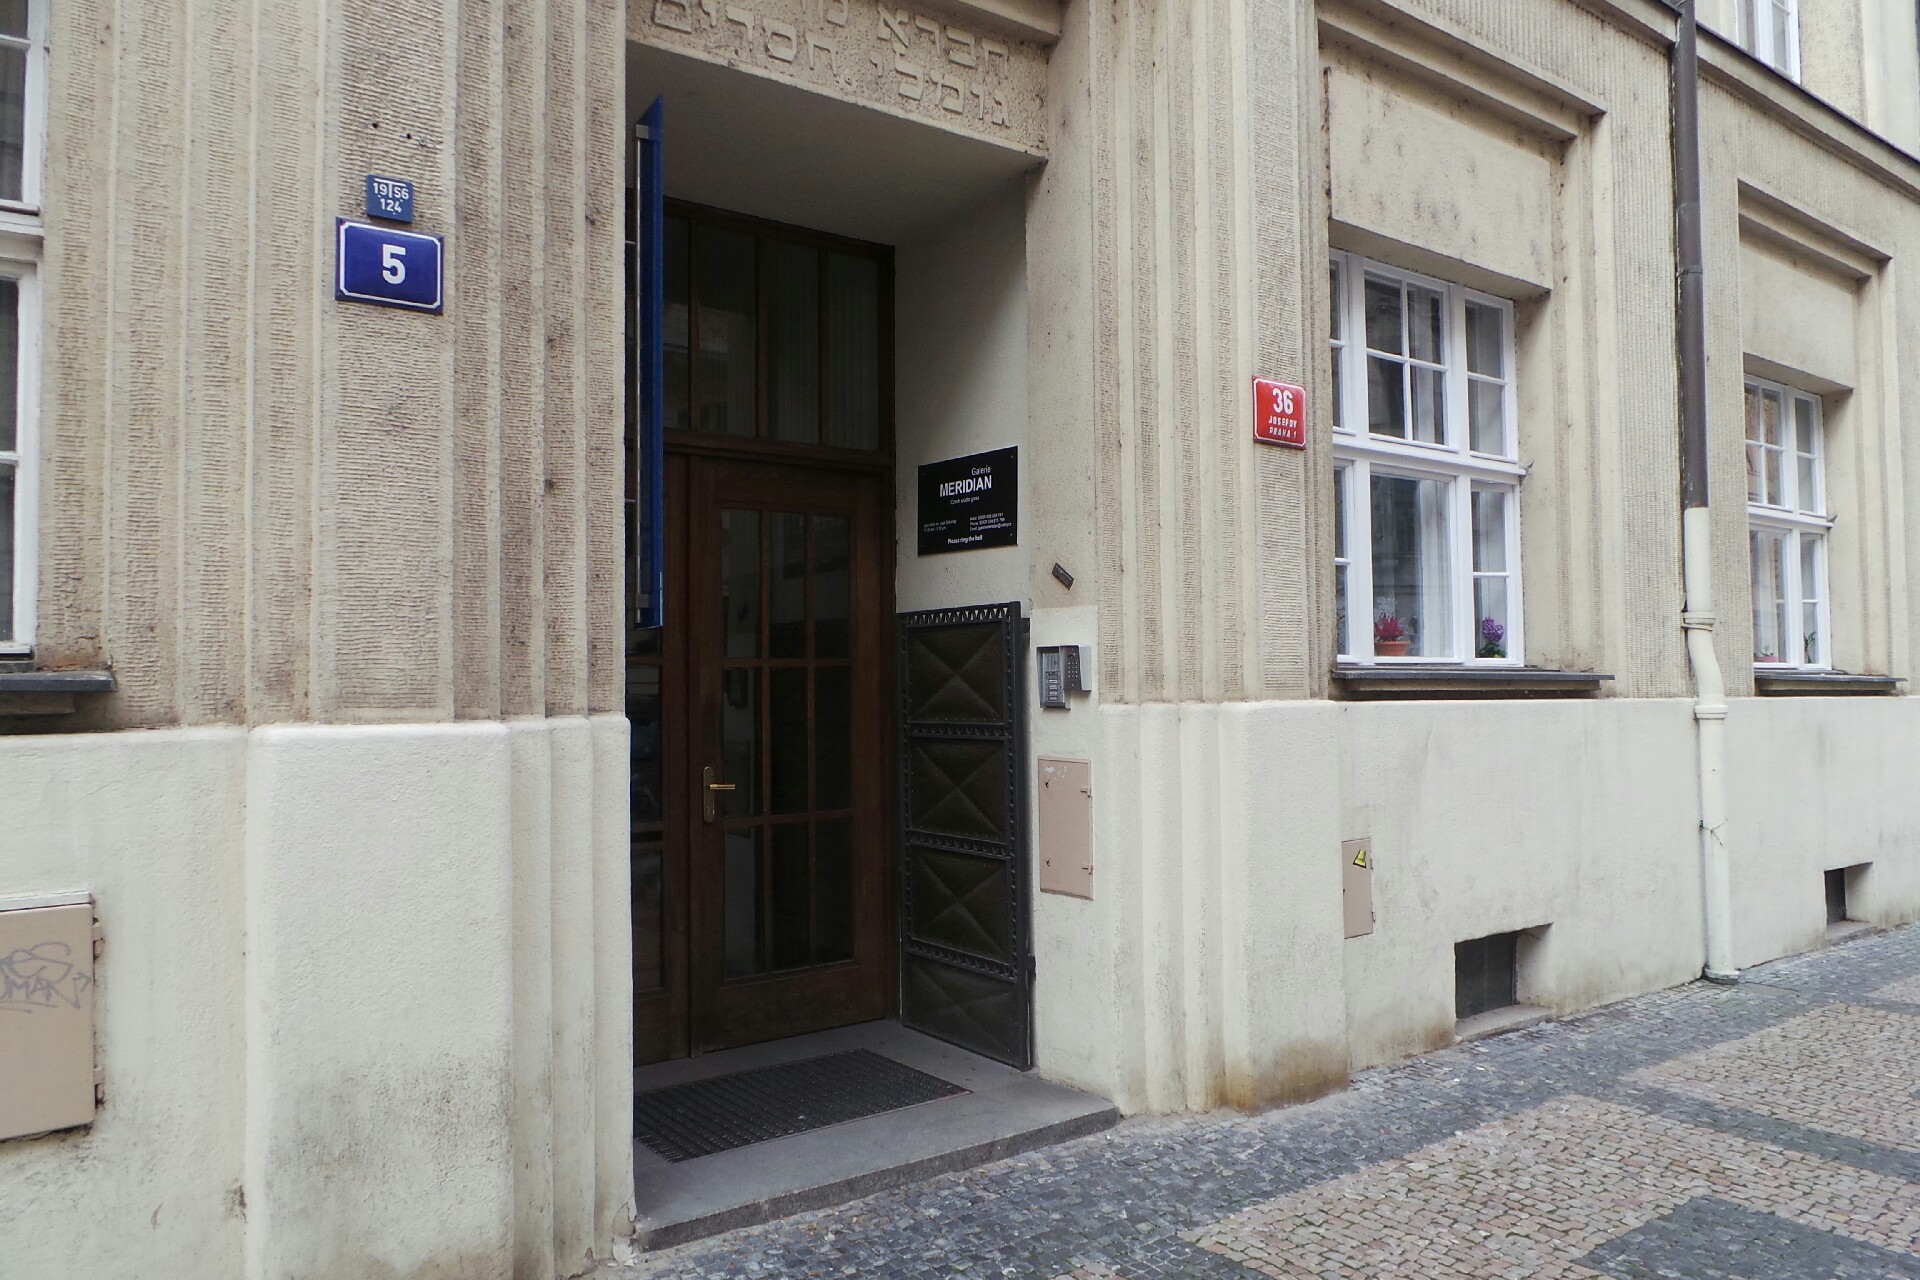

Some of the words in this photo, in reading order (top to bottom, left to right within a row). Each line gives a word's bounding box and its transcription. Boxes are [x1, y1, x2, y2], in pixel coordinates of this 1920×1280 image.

[380, 198, 402, 213] 124
[382, 244, 406, 284] 5
[1272, 388, 1294, 414] 36
[1269, 427, 1291, 438] PRAHA
[971, 464, 991, 476] Galerie
[939, 475, 992, 497] MERIDIAN
